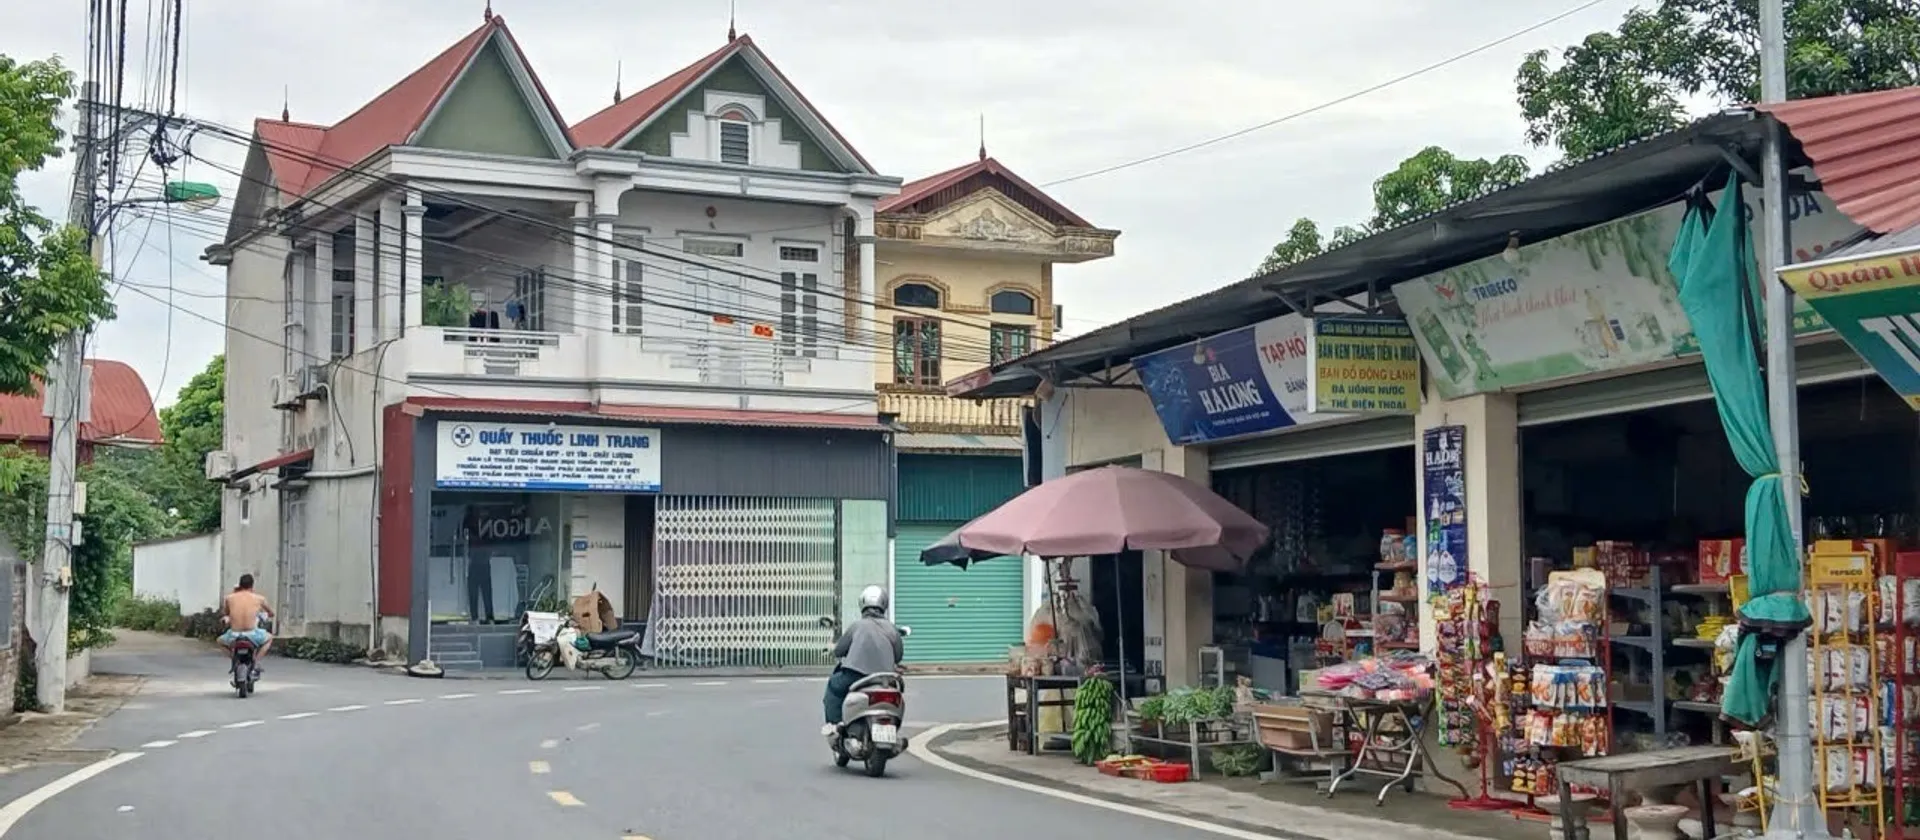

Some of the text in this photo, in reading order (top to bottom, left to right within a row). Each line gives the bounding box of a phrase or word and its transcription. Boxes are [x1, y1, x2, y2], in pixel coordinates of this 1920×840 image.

[1808, 262, 1894, 292] Quán
[1472, 278, 1518, 301] TRIBECO
[1208, 362, 1231, 383] BIA
[1198, 378, 1264, 415] HALONG
[520, 429, 563, 446] THUỐC
[570, 433, 599, 447] LINH
[606, 435, 649, 449] TRANG
